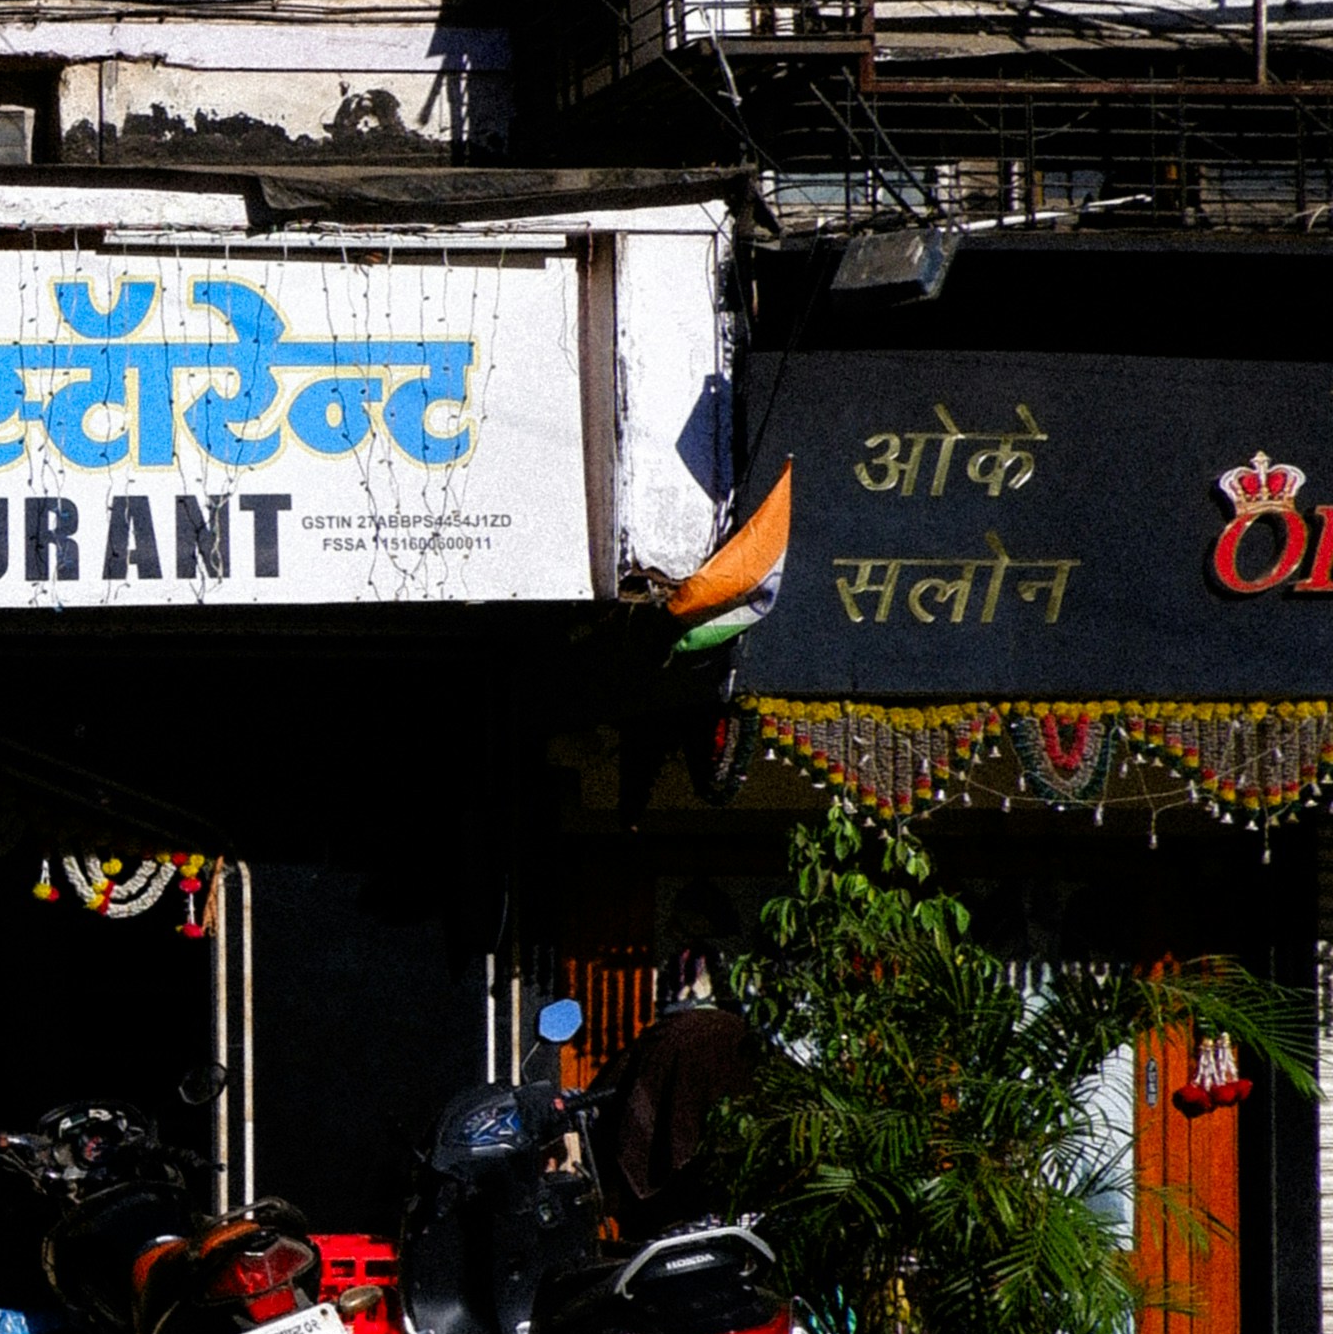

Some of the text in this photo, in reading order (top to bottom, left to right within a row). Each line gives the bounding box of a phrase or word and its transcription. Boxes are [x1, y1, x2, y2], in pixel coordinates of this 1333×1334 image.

[854, 403, 1048, 497] ओके
[301, 515, 352, 530] GSTIN
[322, 537, 367, 552] FSSA
[834, 531, 1081, 624] सलोन
